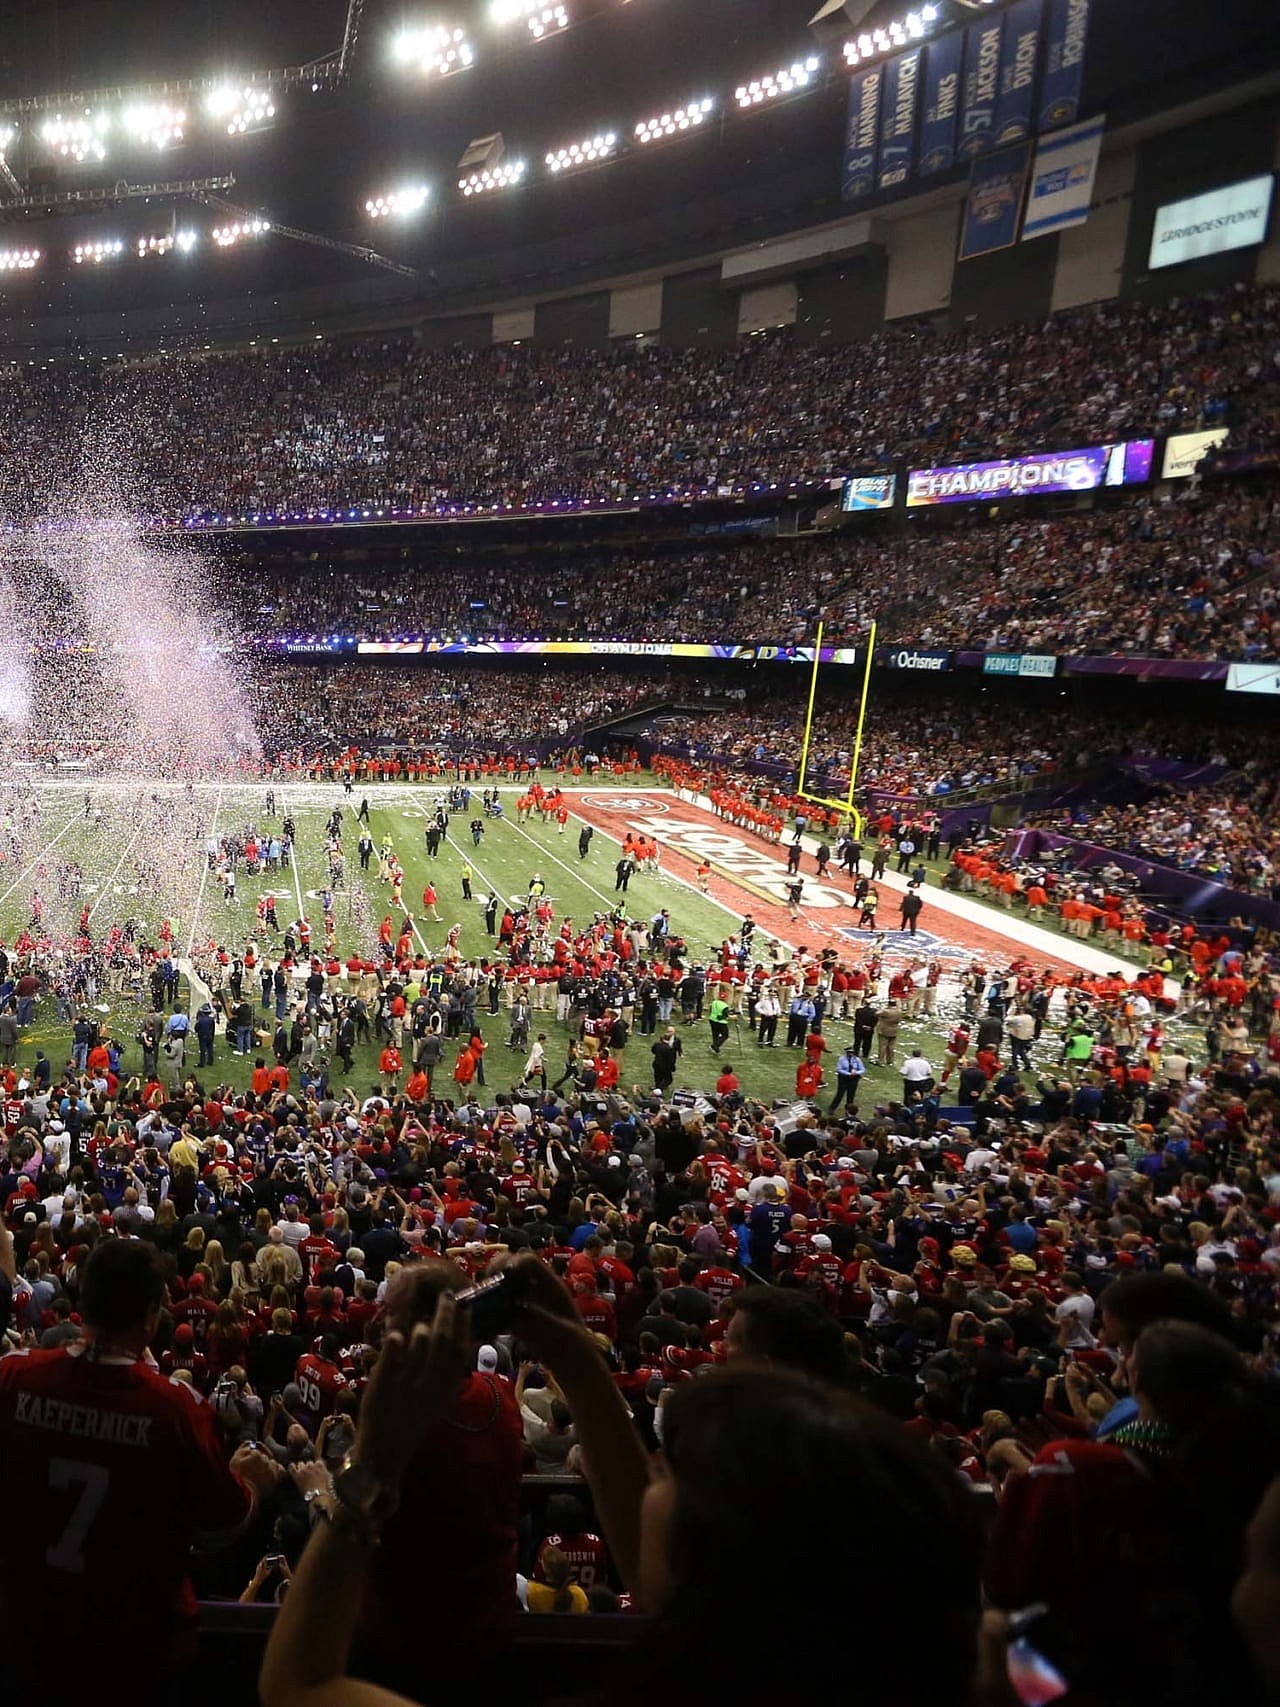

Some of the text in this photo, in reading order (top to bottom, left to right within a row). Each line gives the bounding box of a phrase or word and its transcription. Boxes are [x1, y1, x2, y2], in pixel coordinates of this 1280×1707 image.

[976, 27, 1001, 103] JACKSON
[1013, 30, 1039, 89] DIXON
[857, 72, 881, 150] MANNING
[895, 55, 919, 136] MARAVICH
[936, 73, 959, 121] FINKS
[963, 110, 992, 133] 57
[848, 154, 873, 170] 8
[883, 146, 908, 159] 7
[1160, 206, 1264, 244] BRIDGESTONE
[909, 455, 1090, 498] CHAMPIONS
[590, 642, 672, 655] CHAMPIONS
[897, 651, 946, 671] Ochsner
[625, 816, 862, 909] 49ERS
[584, 1021, 595, 1035] 91
[7, 1110, 20, 1124] 52
[770, 1219, 780, 1233] 5
[298, 1375, 322, 1411] 99
[15, 1391, 153, 1448] KAEPERNICK
[45, 1455, 113, 1575] 7
